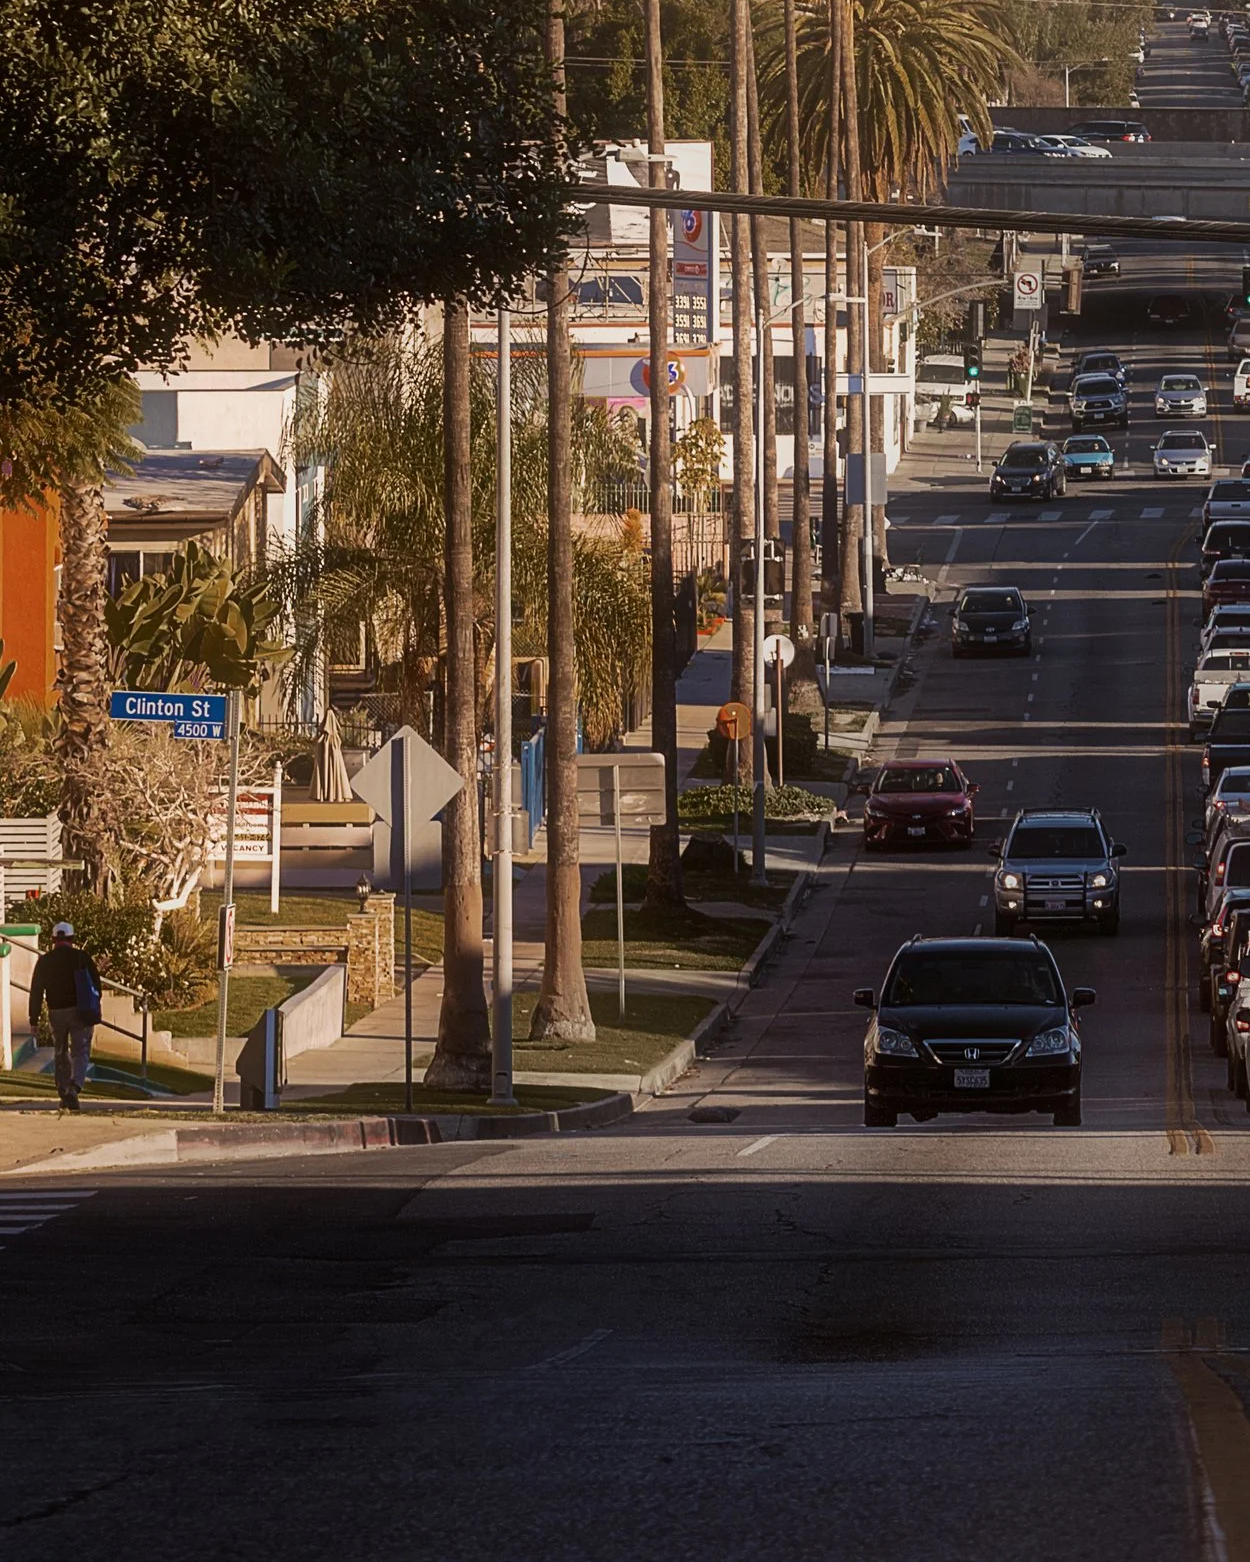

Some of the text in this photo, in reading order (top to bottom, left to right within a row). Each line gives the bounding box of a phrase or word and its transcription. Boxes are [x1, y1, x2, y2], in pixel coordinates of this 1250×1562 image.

[125, 697, 211, 717] Clinton St
[177, 724, 222, 737] 4500 W
